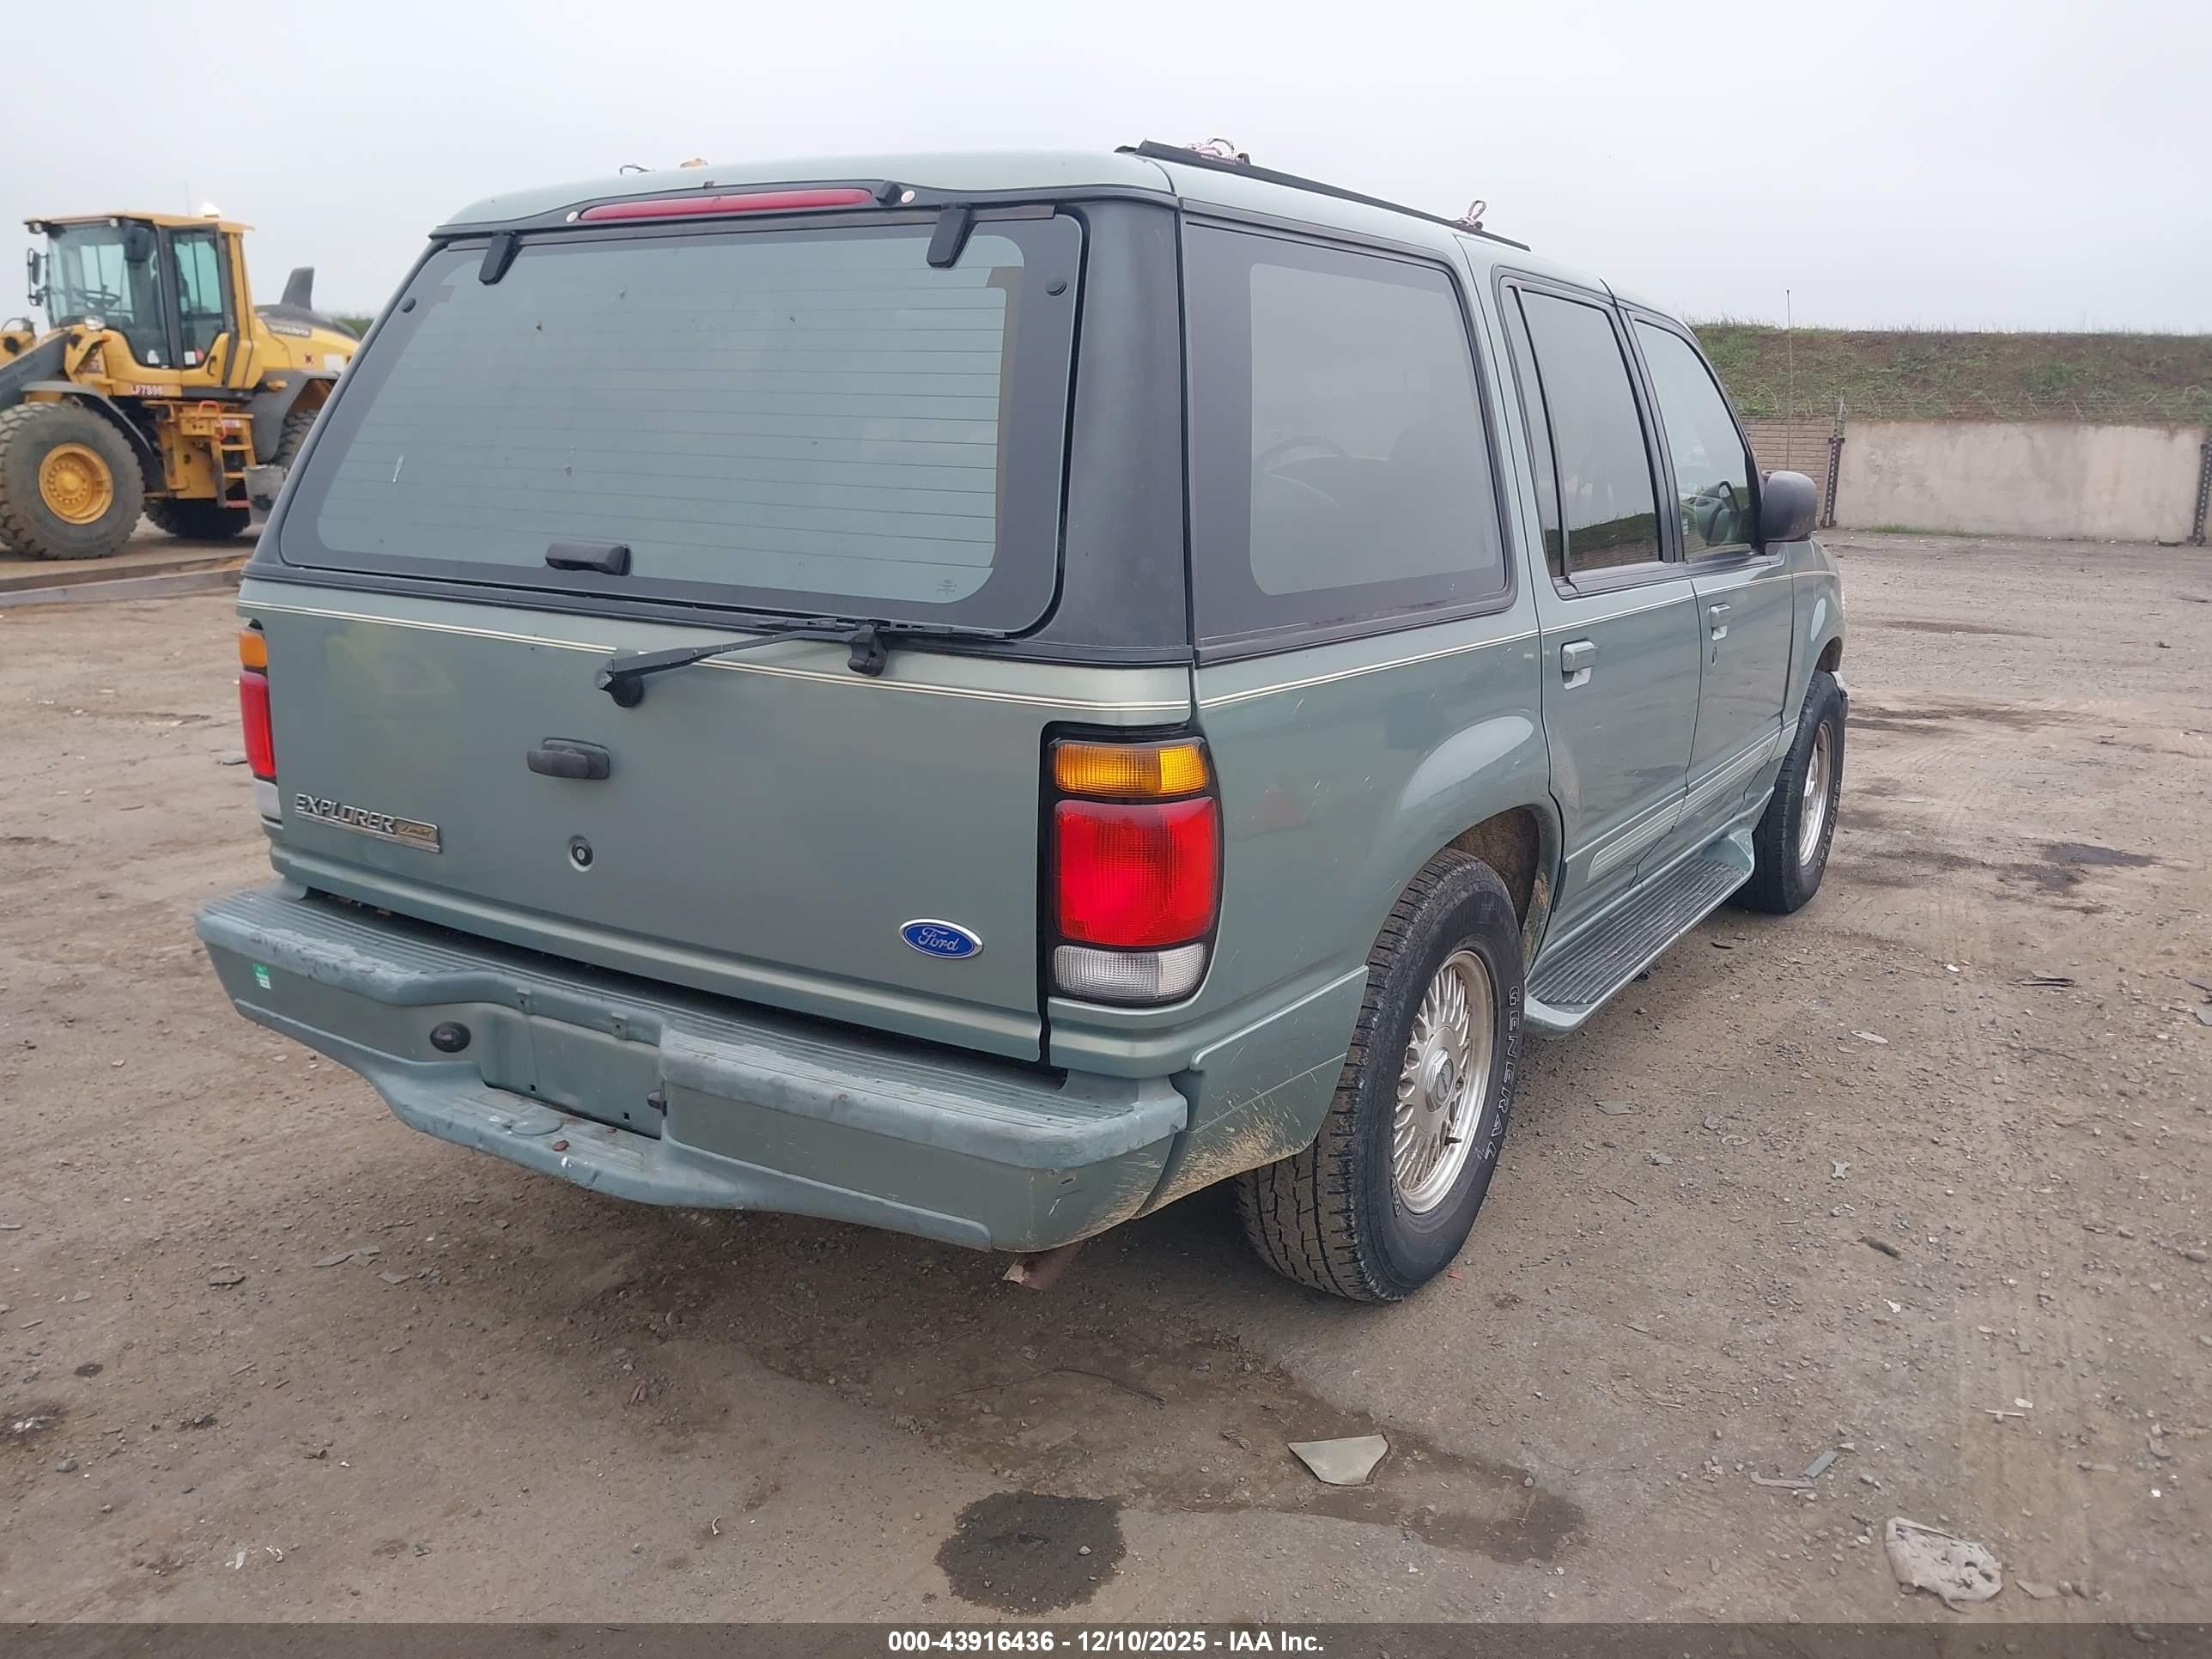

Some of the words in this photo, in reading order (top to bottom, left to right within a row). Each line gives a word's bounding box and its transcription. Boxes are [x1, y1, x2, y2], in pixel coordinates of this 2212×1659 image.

[295, 793, 396, 833] EXPLORER
[917, 927, 960, 951] Ford
[1484, 985, 1520, 1160] GENERAL
